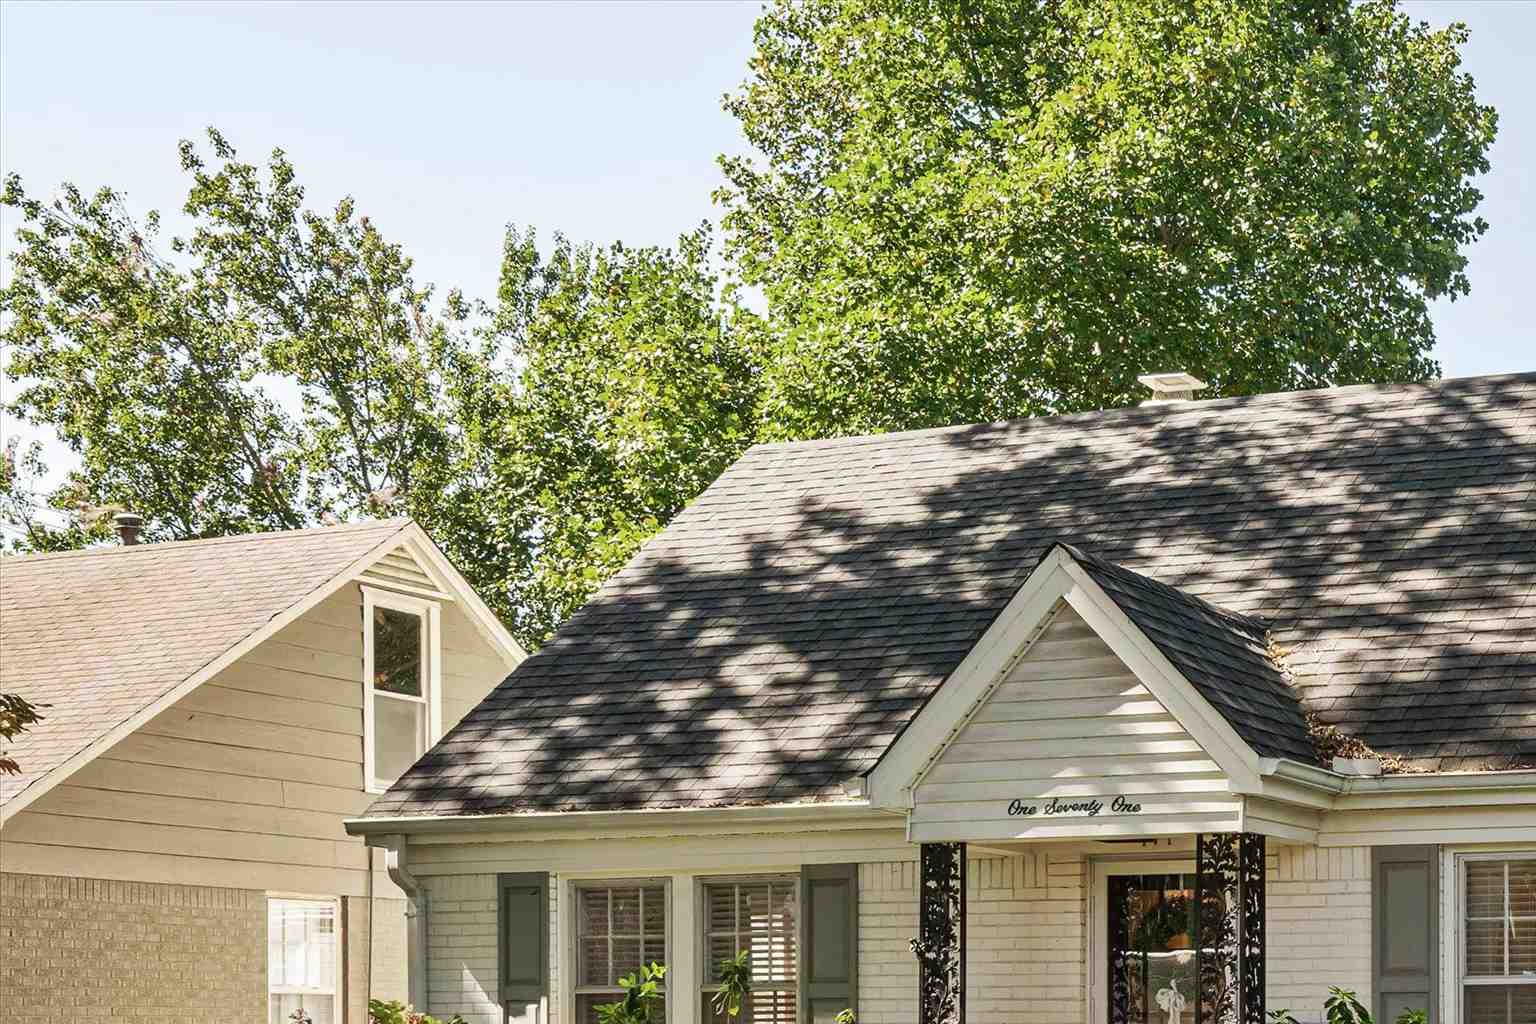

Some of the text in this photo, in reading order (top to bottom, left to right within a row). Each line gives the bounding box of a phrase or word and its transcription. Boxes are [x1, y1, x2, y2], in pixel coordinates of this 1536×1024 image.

[1008, 794, 1142, 817] One Seventy One
